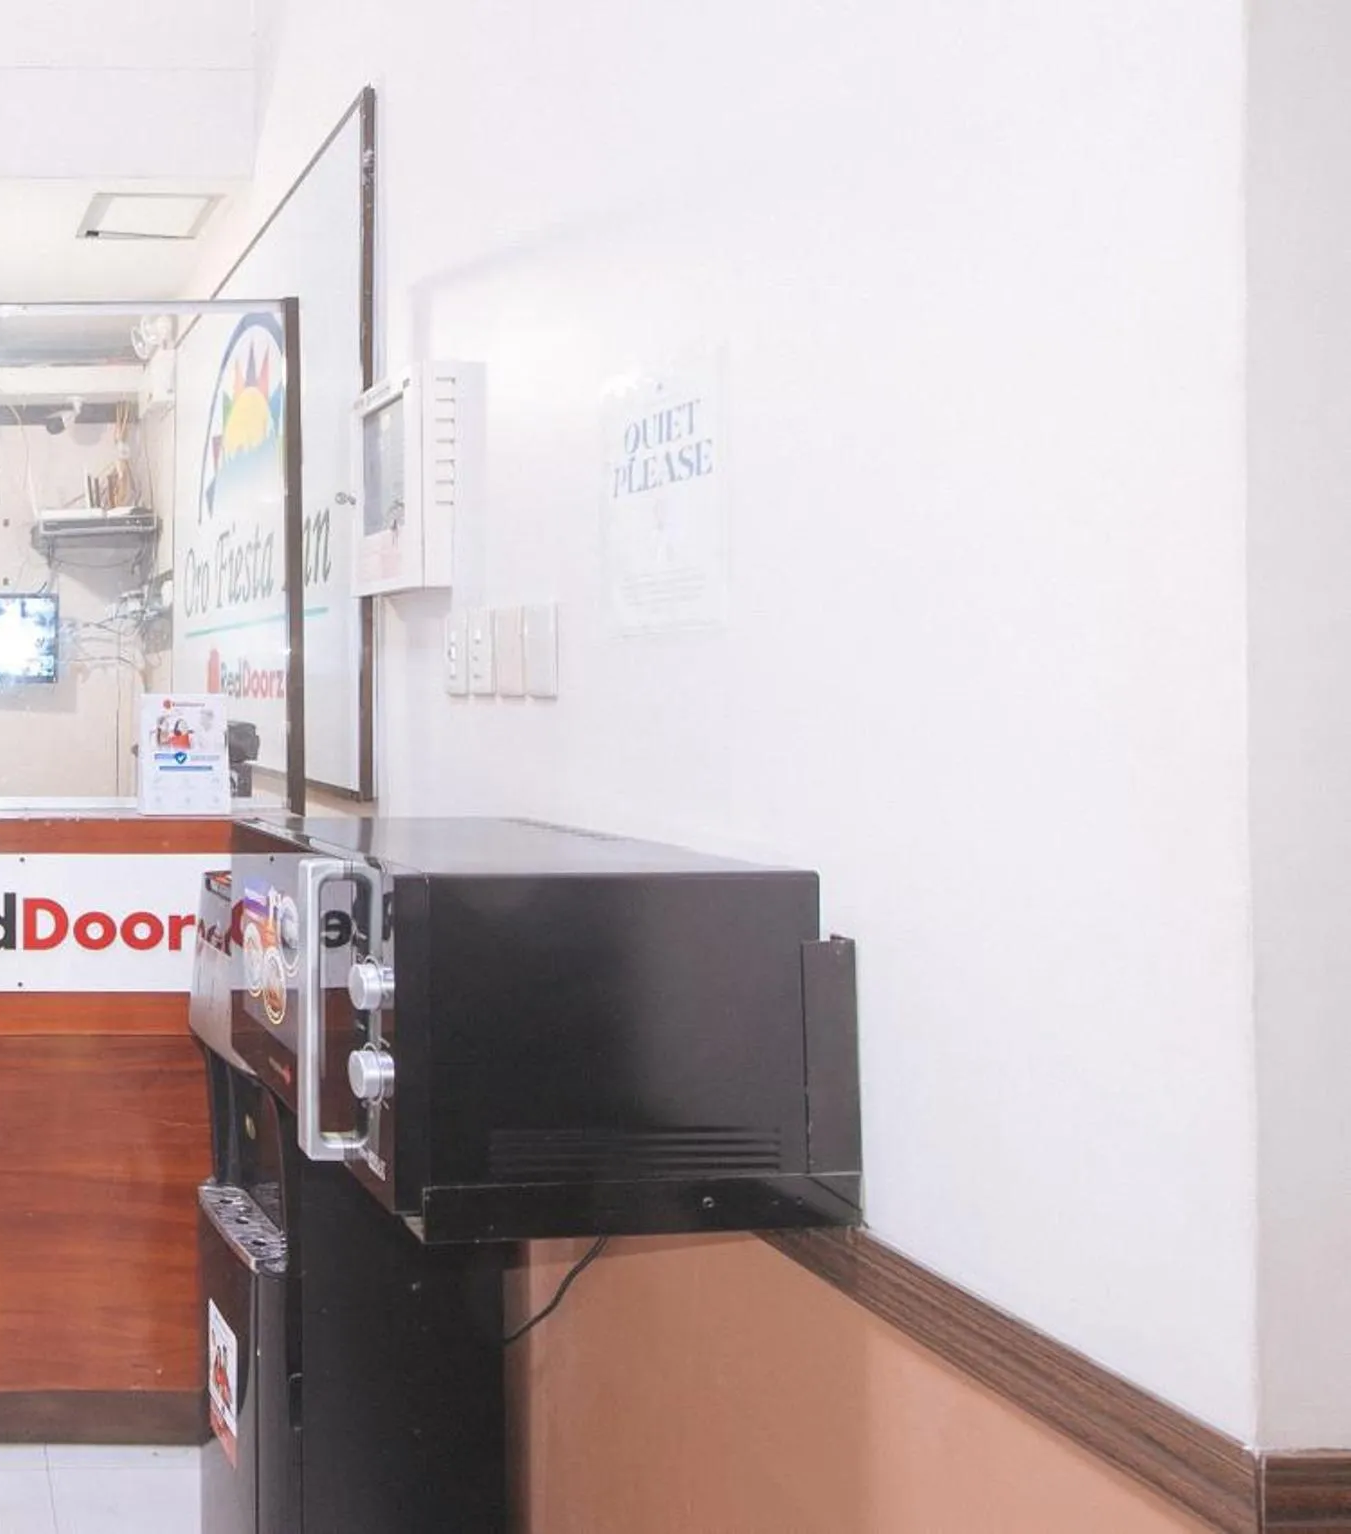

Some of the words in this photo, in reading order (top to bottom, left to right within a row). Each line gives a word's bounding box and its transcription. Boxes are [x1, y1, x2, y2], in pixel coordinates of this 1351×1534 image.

[623, 399, 702, 454] QUIET
[612, 438, 714, 498] PLEASE
[184, 547, 210, 618] Oro
[215, 520, 274, 608] Fiesta
